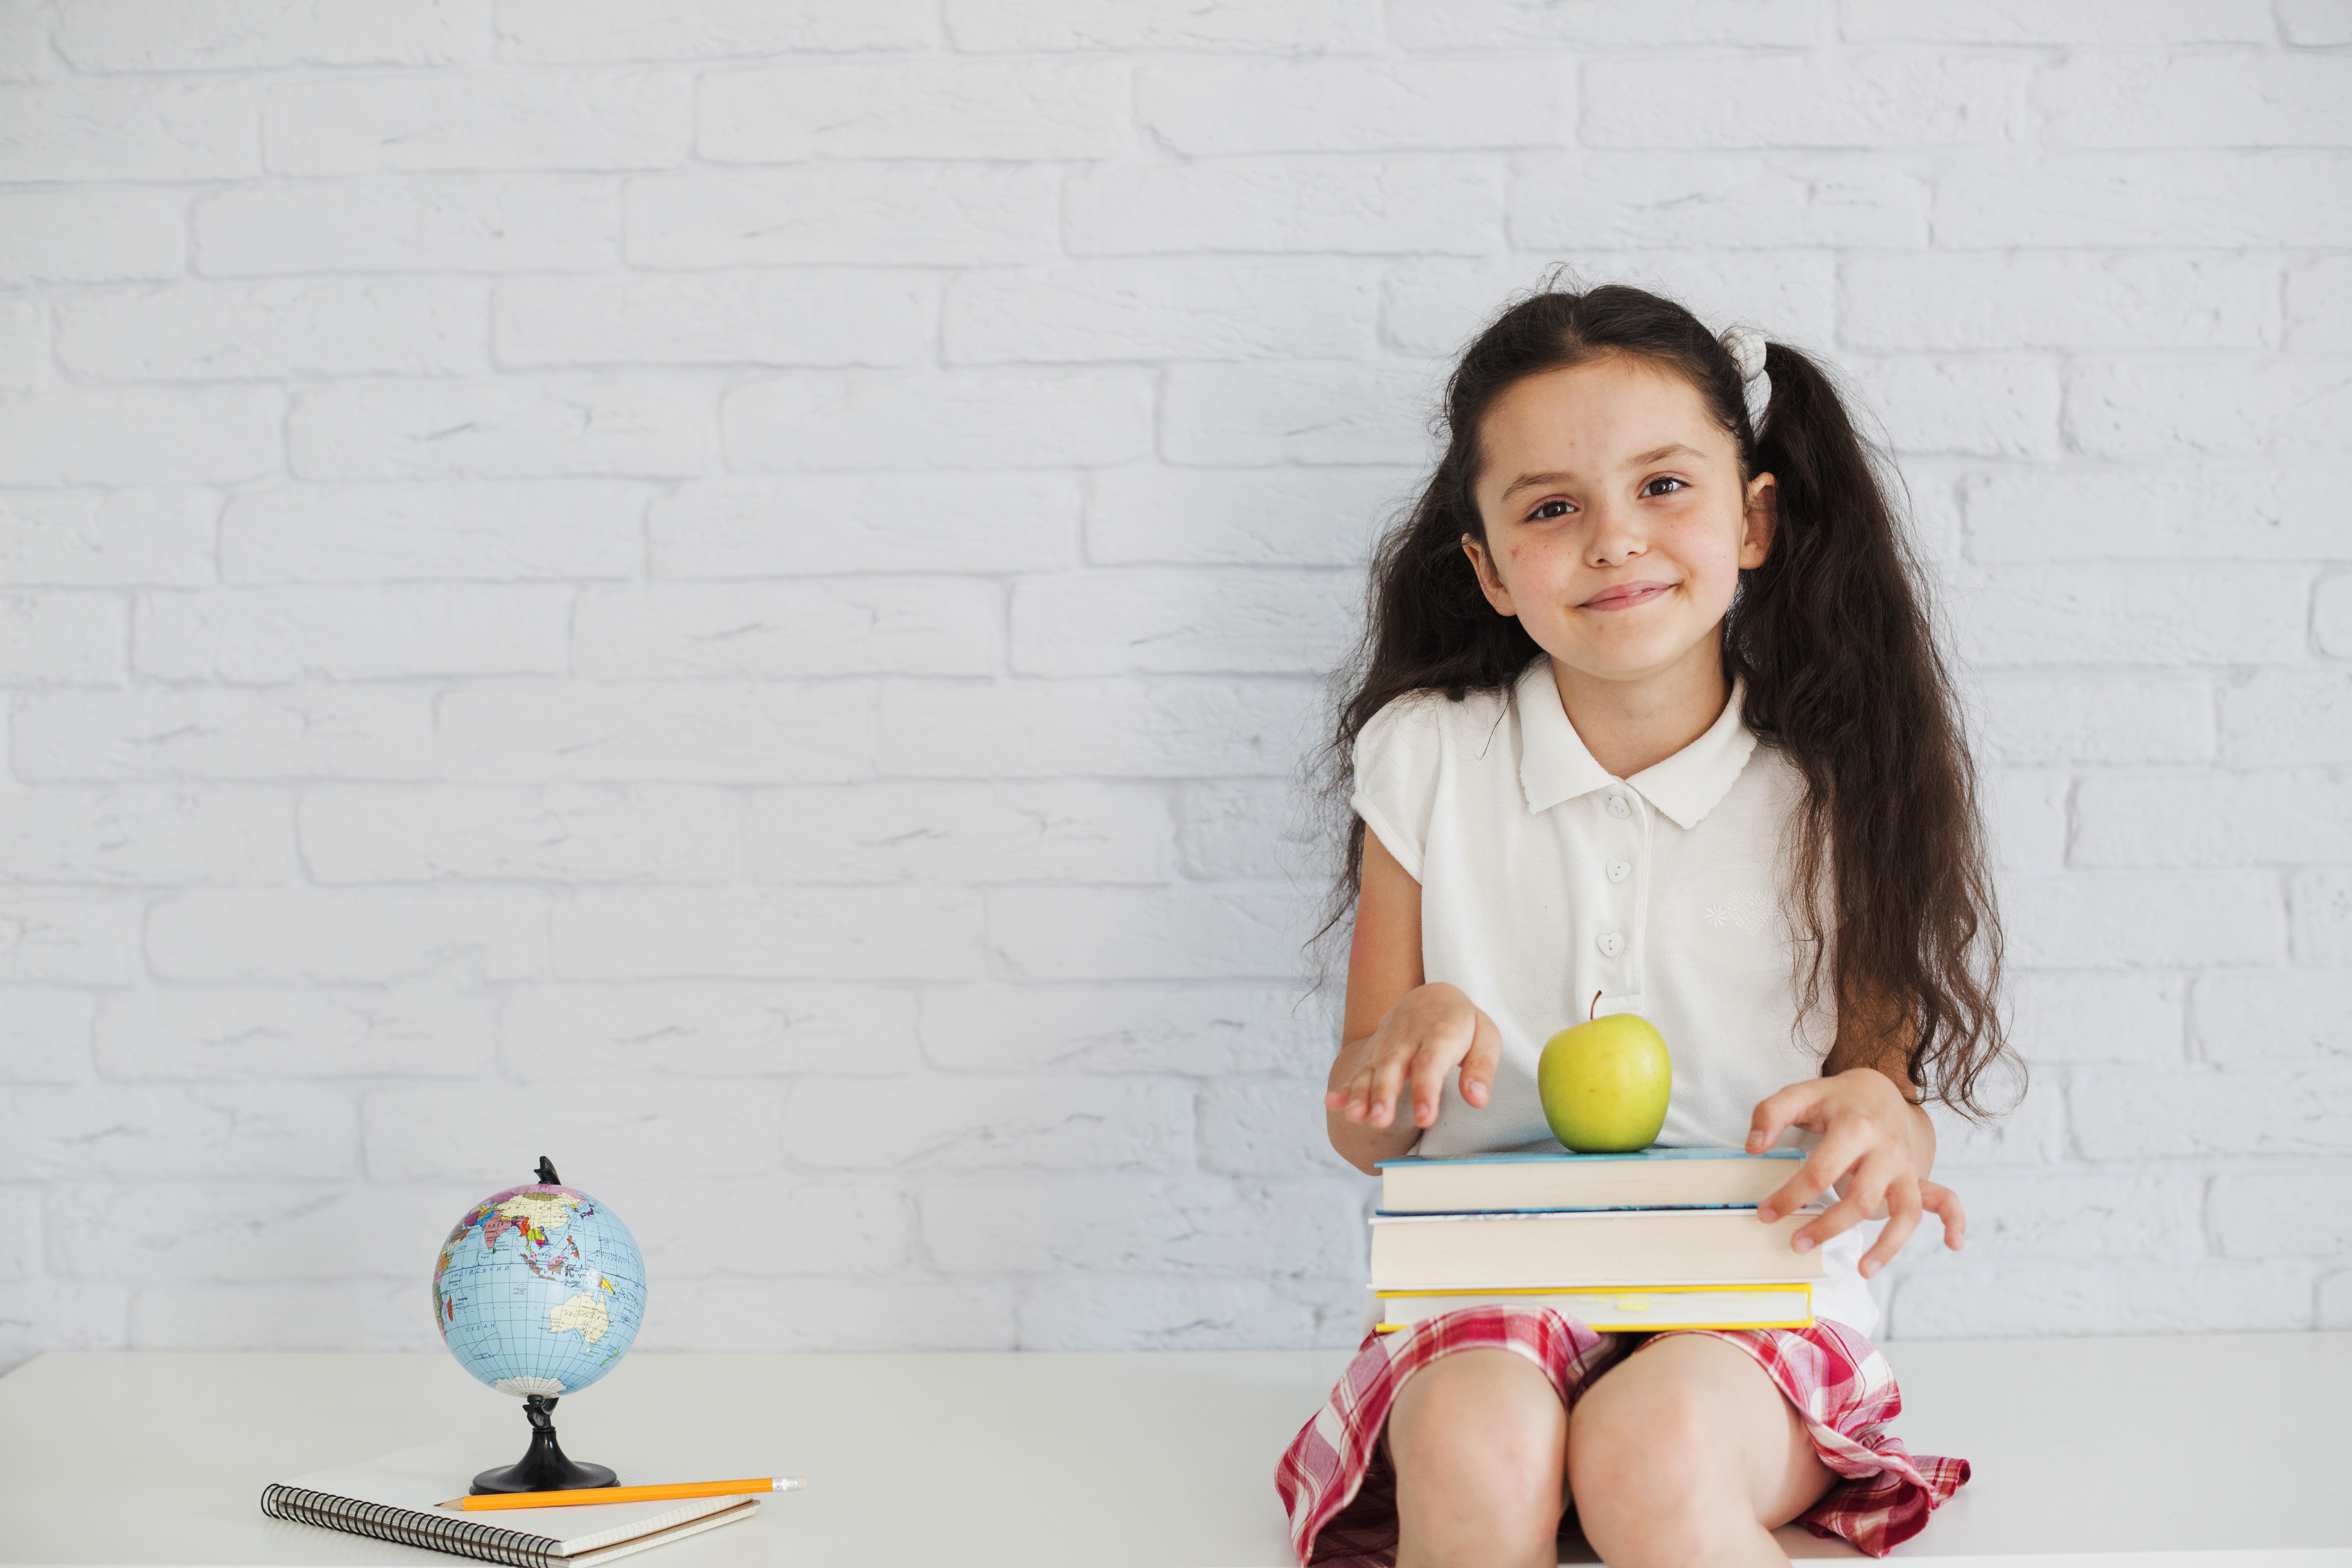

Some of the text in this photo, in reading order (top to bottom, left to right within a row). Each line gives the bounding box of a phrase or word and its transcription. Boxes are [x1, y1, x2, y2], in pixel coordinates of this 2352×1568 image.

[452, 1265, 509, 1277] ІНДІЙСЬКИЙ
[564, 1312, 600, 1320] АВСТРАЛІЯ
[466, 1323, 494, 1332] ОКЕАН
